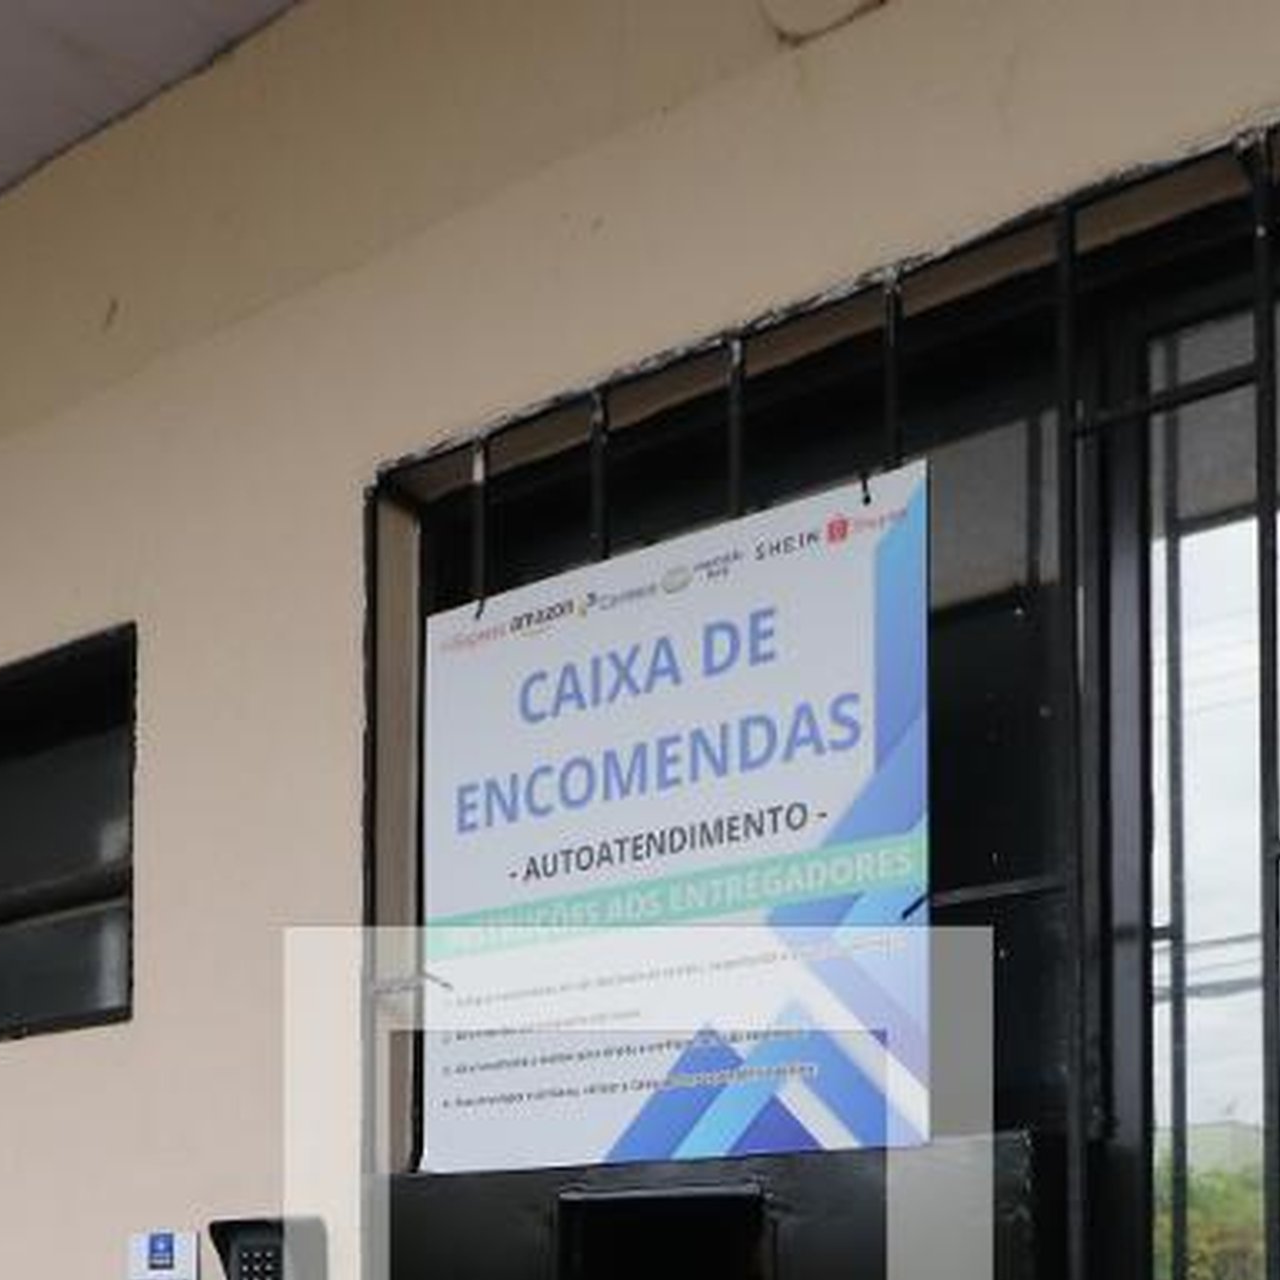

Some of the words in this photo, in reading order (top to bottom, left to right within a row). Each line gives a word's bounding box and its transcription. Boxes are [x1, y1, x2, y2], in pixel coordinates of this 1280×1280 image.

[518, 636, 683, 724] CAIXA
[702, 608, 777, 678] DE
[455, 692, 862, 834] ENCOMENDAS
[522, 801, 809, 882] AUTOATENDIMENTO
[671, 848, 913, 910] ENTREGADORES
